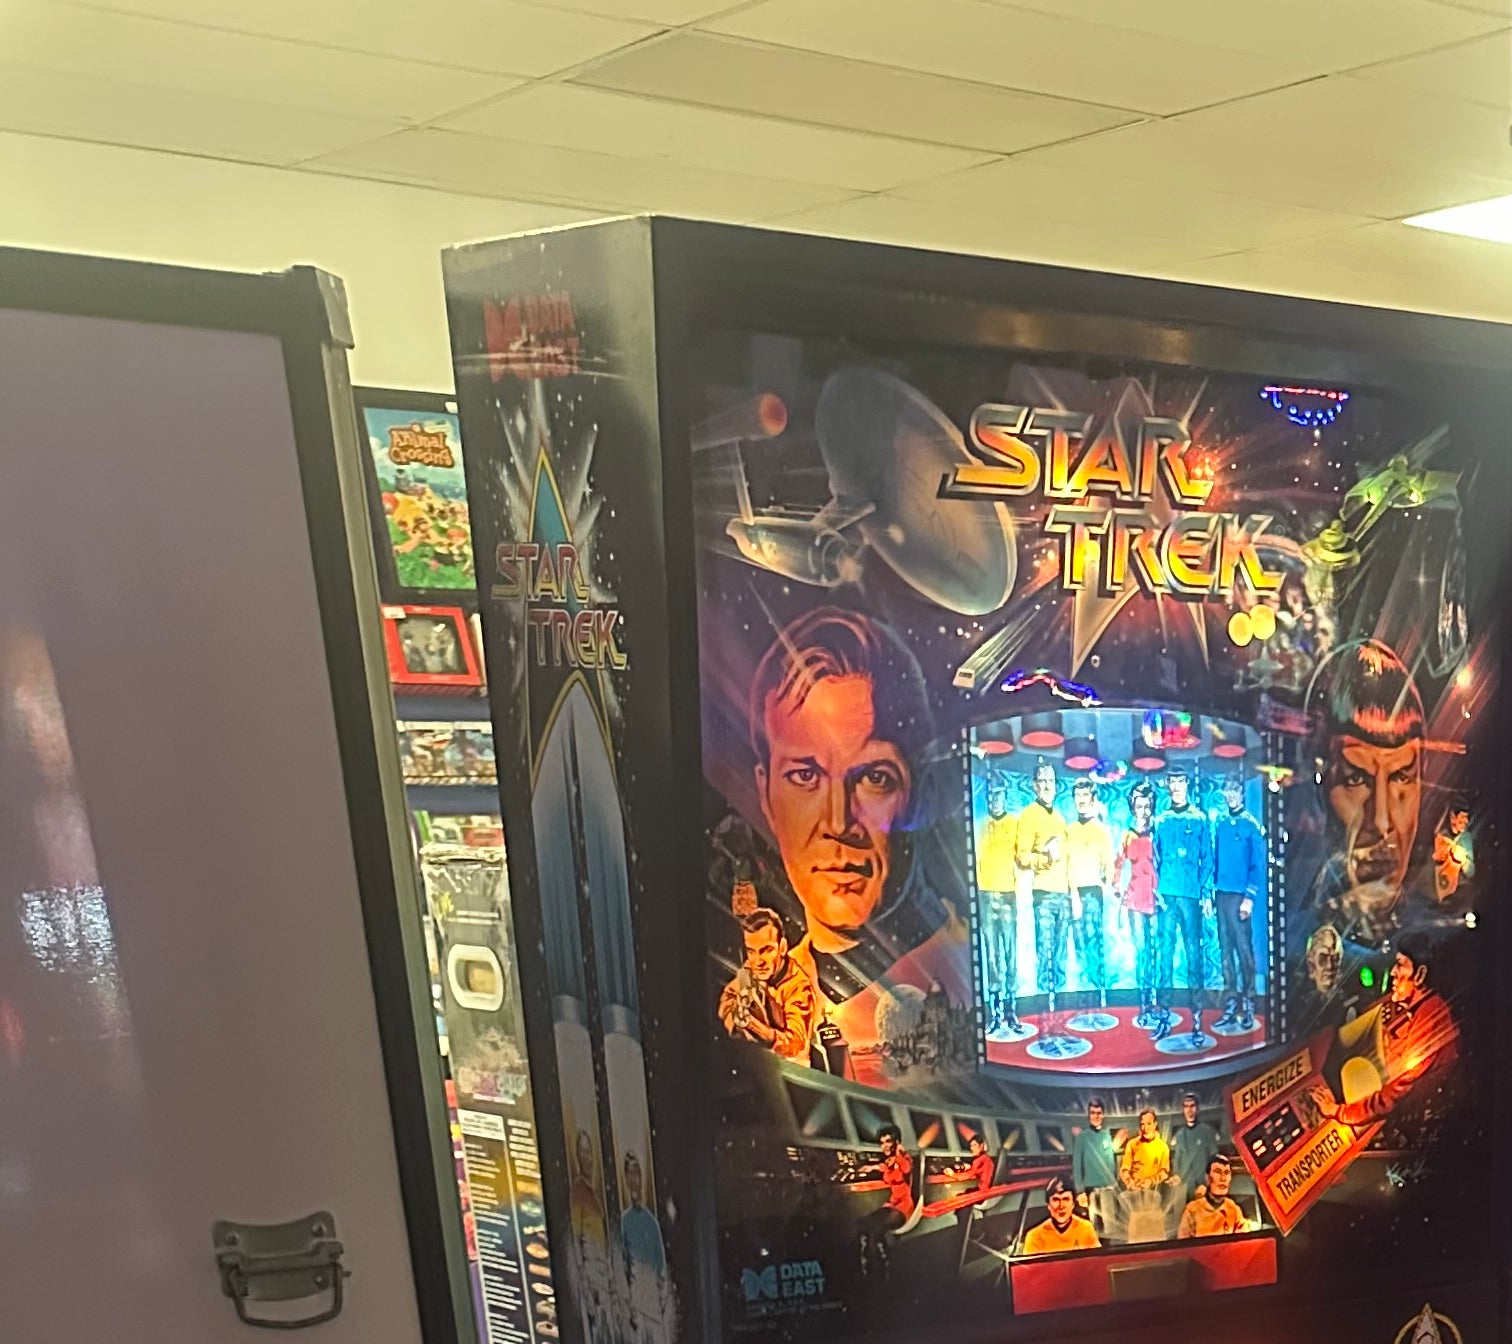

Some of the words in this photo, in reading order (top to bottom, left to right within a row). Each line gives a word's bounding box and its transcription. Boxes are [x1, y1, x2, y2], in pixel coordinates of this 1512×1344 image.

[946, 404, 1213, 505] STAR
[491, 543, 590, 602] STAR
[1045, 505, 1286, 597] TREK
[529, 609, 628, 671] TREK
[1241, 1054, 1304, 1113] ENERGIZE
[1276, 1128, 1344, 1201] TRANSPORTER
[780, 1260, 823, 1280] DATA
[782, 1278, 827, 1298] EAST
